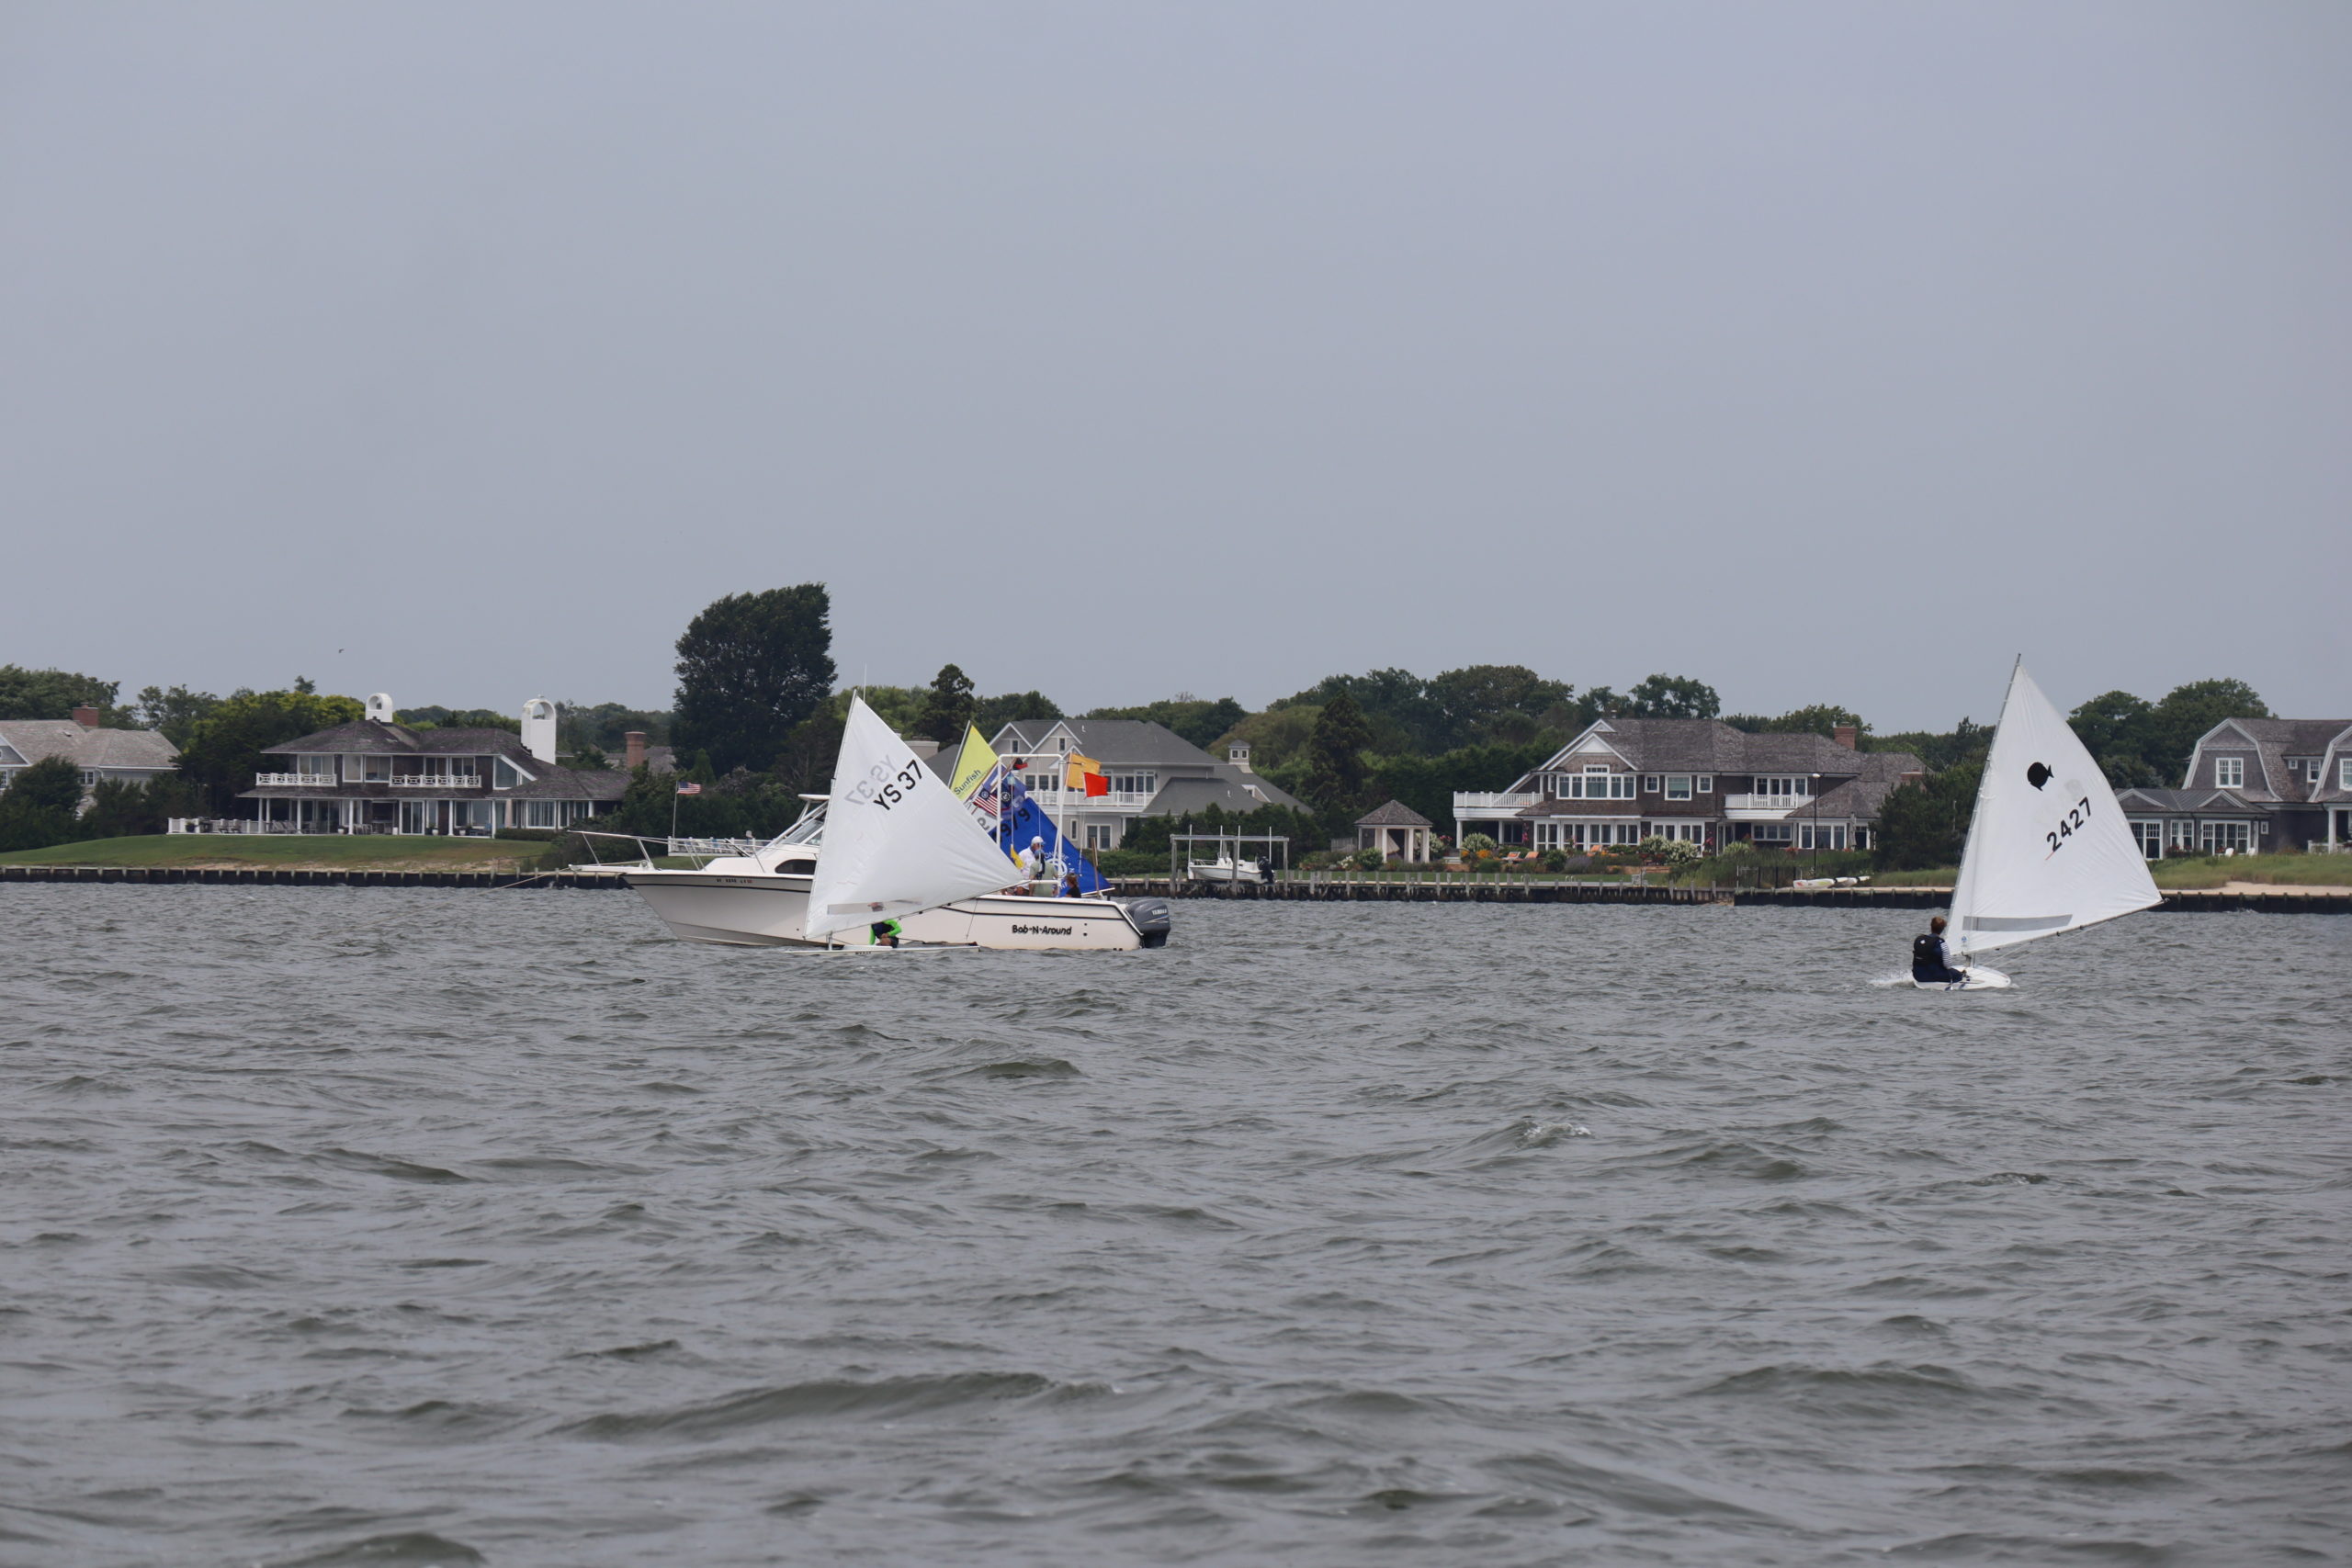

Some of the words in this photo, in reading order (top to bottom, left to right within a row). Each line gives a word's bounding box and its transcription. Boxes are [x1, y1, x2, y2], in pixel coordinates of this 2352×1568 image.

[897, 759, 922, 790] 37
[954, 769, 982, 795] Sunfish
[2046, 796, 2091, 852] 2427
[1012, 924, 1072, 935] Bob-N-Around
